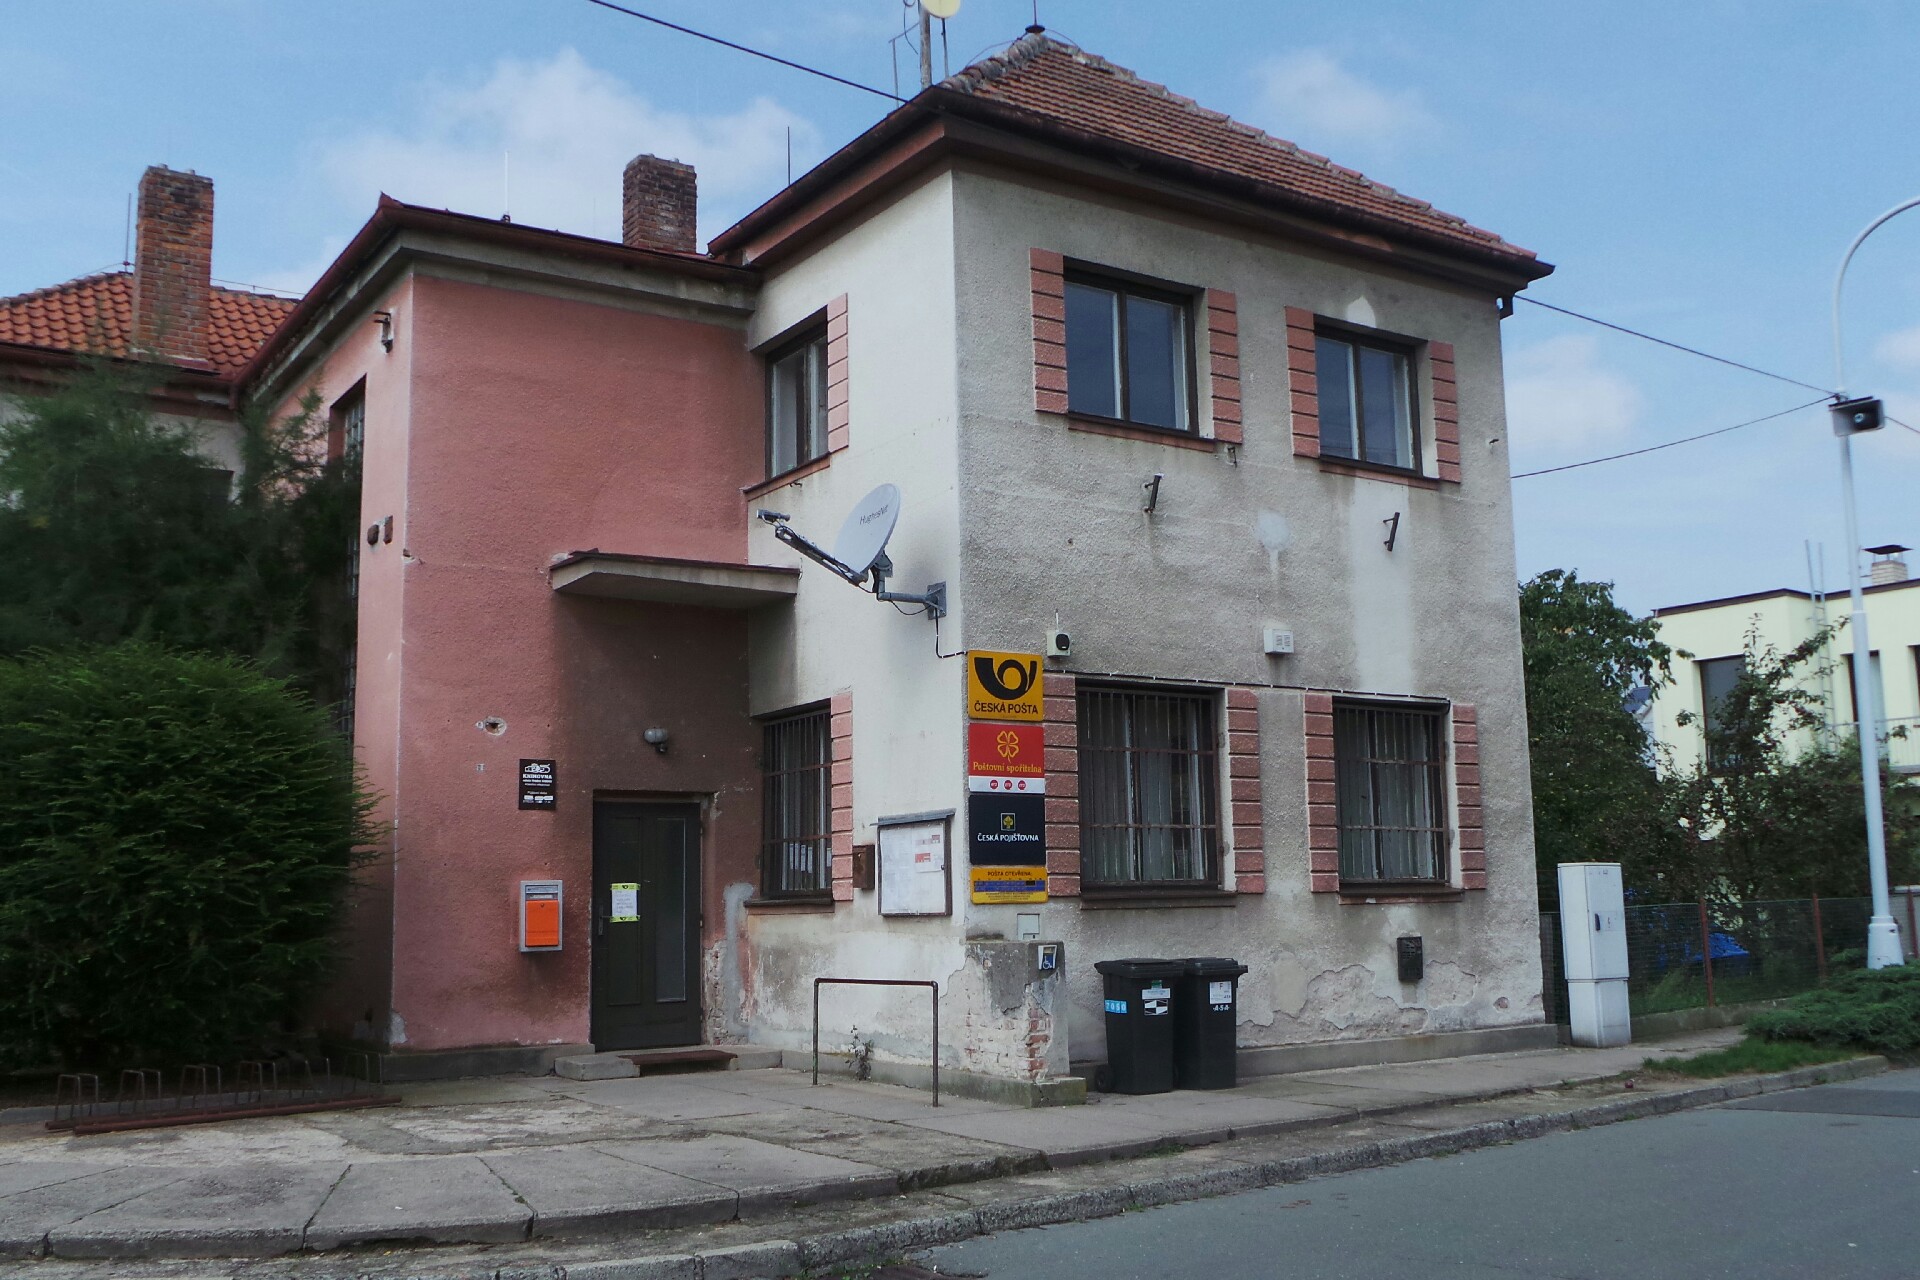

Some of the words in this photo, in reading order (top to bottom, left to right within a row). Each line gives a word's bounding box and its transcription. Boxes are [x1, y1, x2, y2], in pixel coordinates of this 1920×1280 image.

[974, 700, 1006, 713] ČESKÁ
[1008, 703, 1038, 714] POŠTA
[973, 761, 1005, 772] Poštovní
[1006, 763, 1042, 774] spořitelna
[977, 832, 999, 842] ČESKÁ
[1000, 833, 1039, 843] POJIŠŤOVNA
